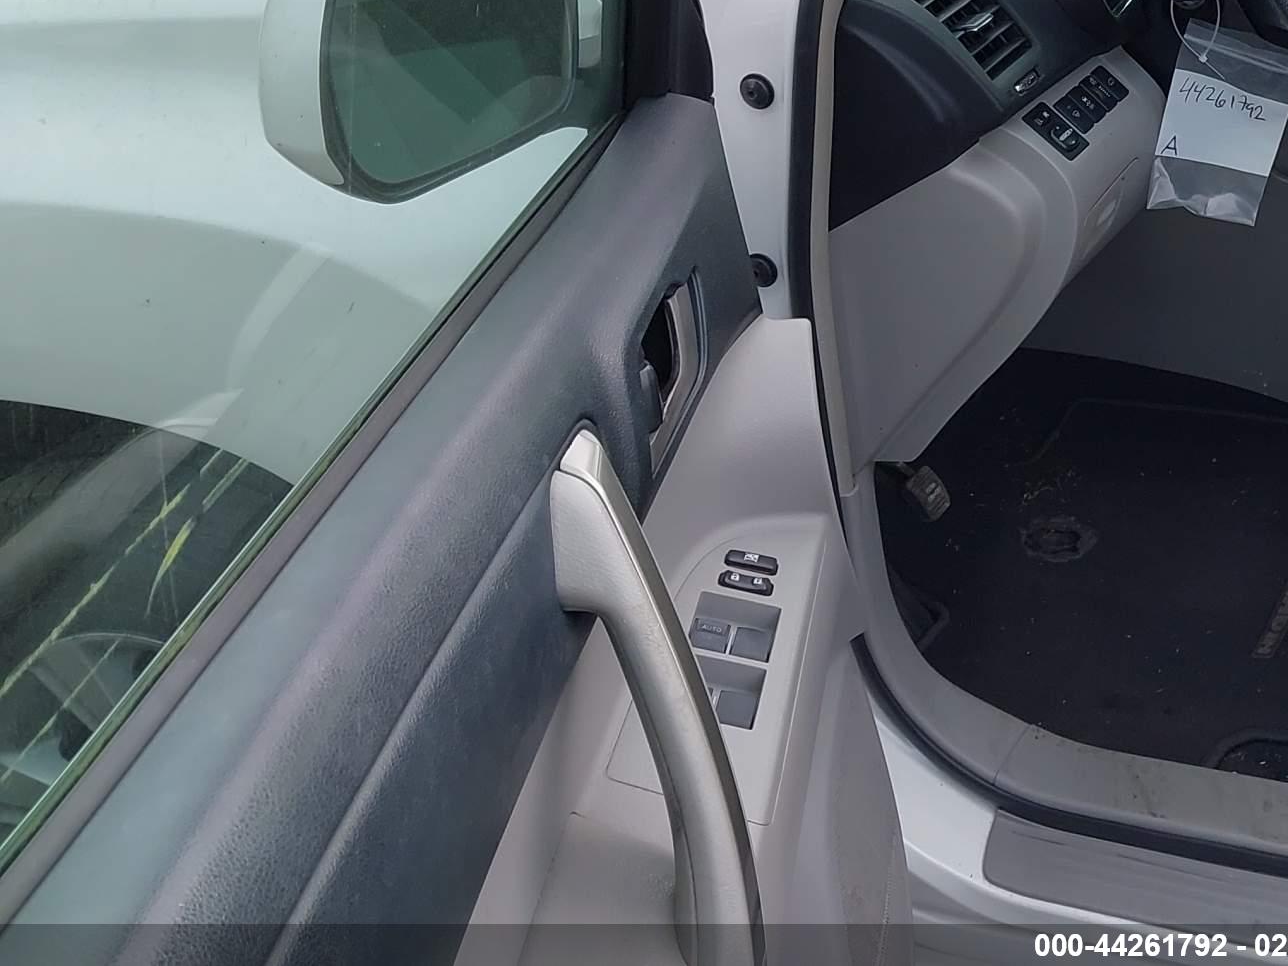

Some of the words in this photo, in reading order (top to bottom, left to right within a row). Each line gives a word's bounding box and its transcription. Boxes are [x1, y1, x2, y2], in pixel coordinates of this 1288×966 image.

[1178, 76, 1267, 122] 44261792
[1160, 135, 1178, 156] A
[701, 624, 723, 634] AUTO
